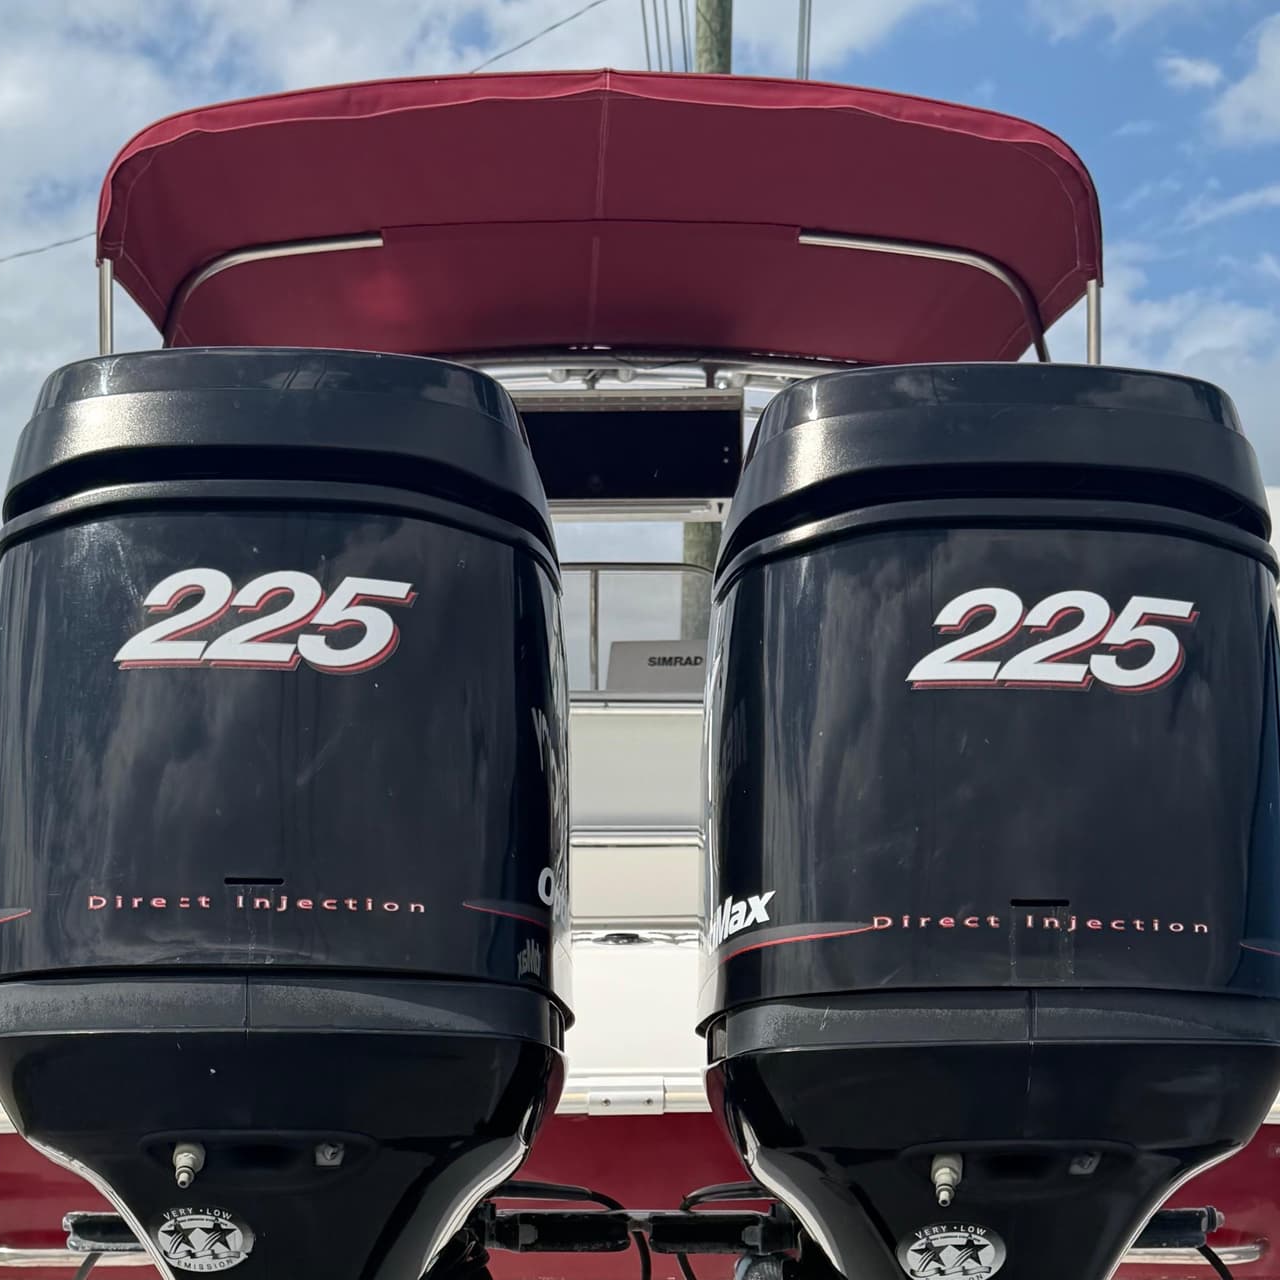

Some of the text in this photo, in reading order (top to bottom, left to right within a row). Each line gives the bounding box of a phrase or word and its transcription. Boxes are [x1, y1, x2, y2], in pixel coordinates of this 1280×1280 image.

[113, 568, 417, 674] 225
[905, 587, 1200, 693] 225
[647, 655, 704, 667] SIMRAD
[236, 895, 426, 913] Injection
[872, 915, 1209, 932] Direct Injection
[163, 1207, 232, 1220] VERY LOW
[915, 1225, 986, 1239] VERY LOW
[177, 1259, 233, 1271] EMISSION
